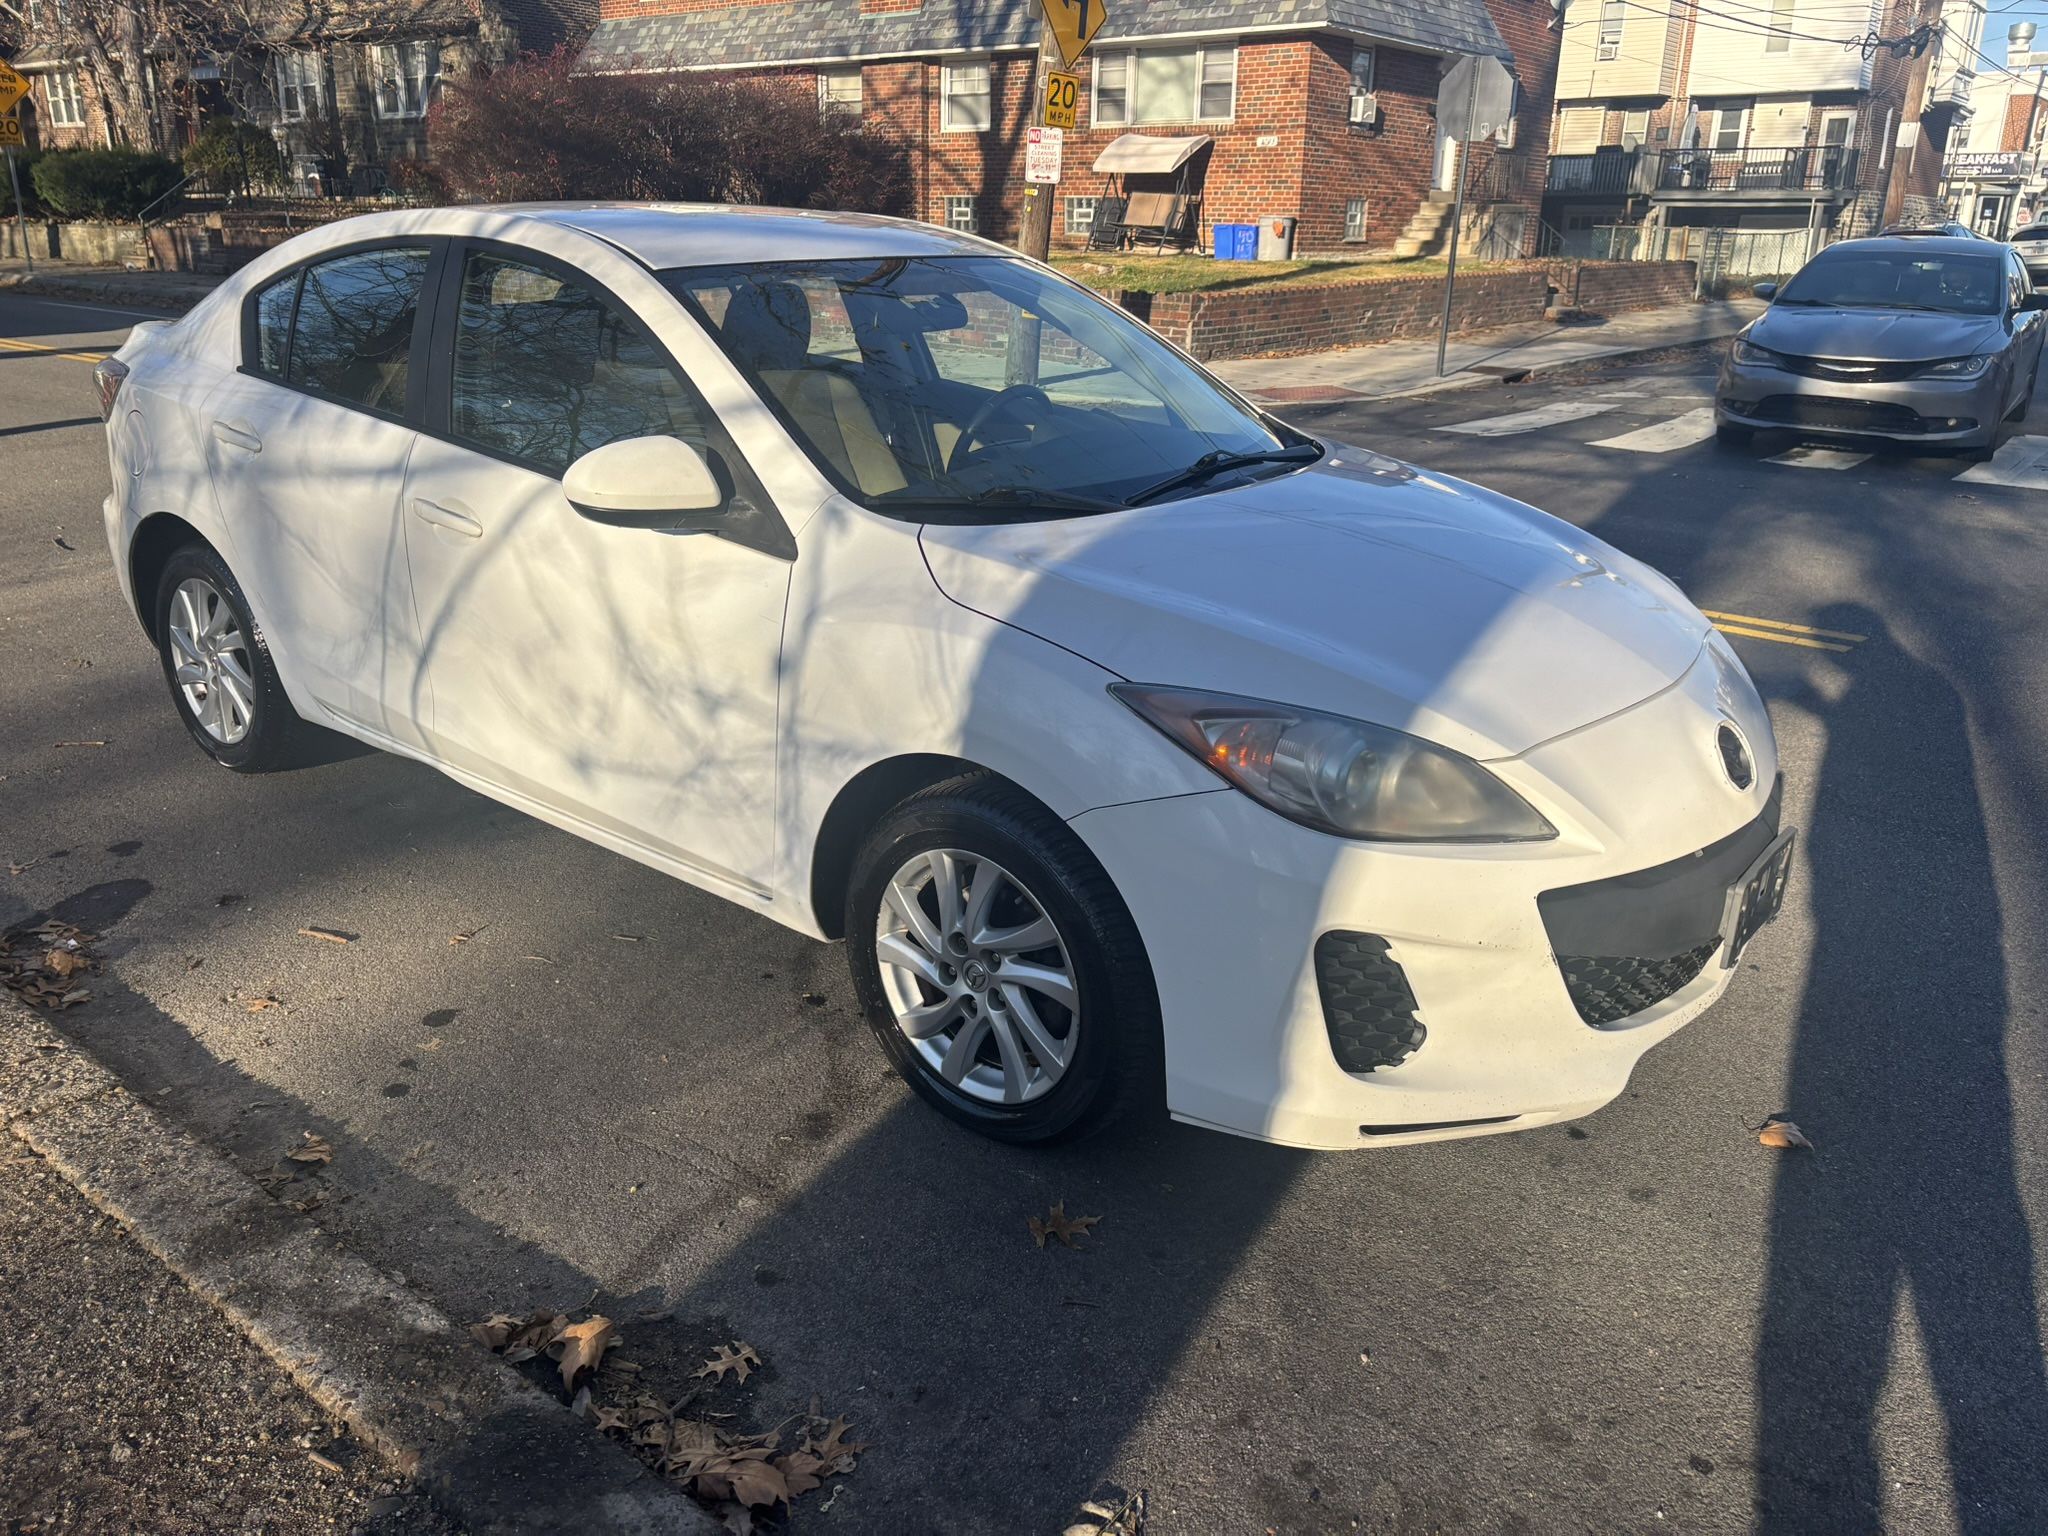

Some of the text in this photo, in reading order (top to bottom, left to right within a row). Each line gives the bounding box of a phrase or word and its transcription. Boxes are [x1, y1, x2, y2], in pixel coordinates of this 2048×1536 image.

[1048, 78, 1075, 109] 20
[1049, 111, 1072, 124] MPH
[1029, 129, 1060, 143] NO PARKING
[1030, 156, 1057, 164] TUESDAY
[1943, 153, 2017, 165] BREAKFAST
